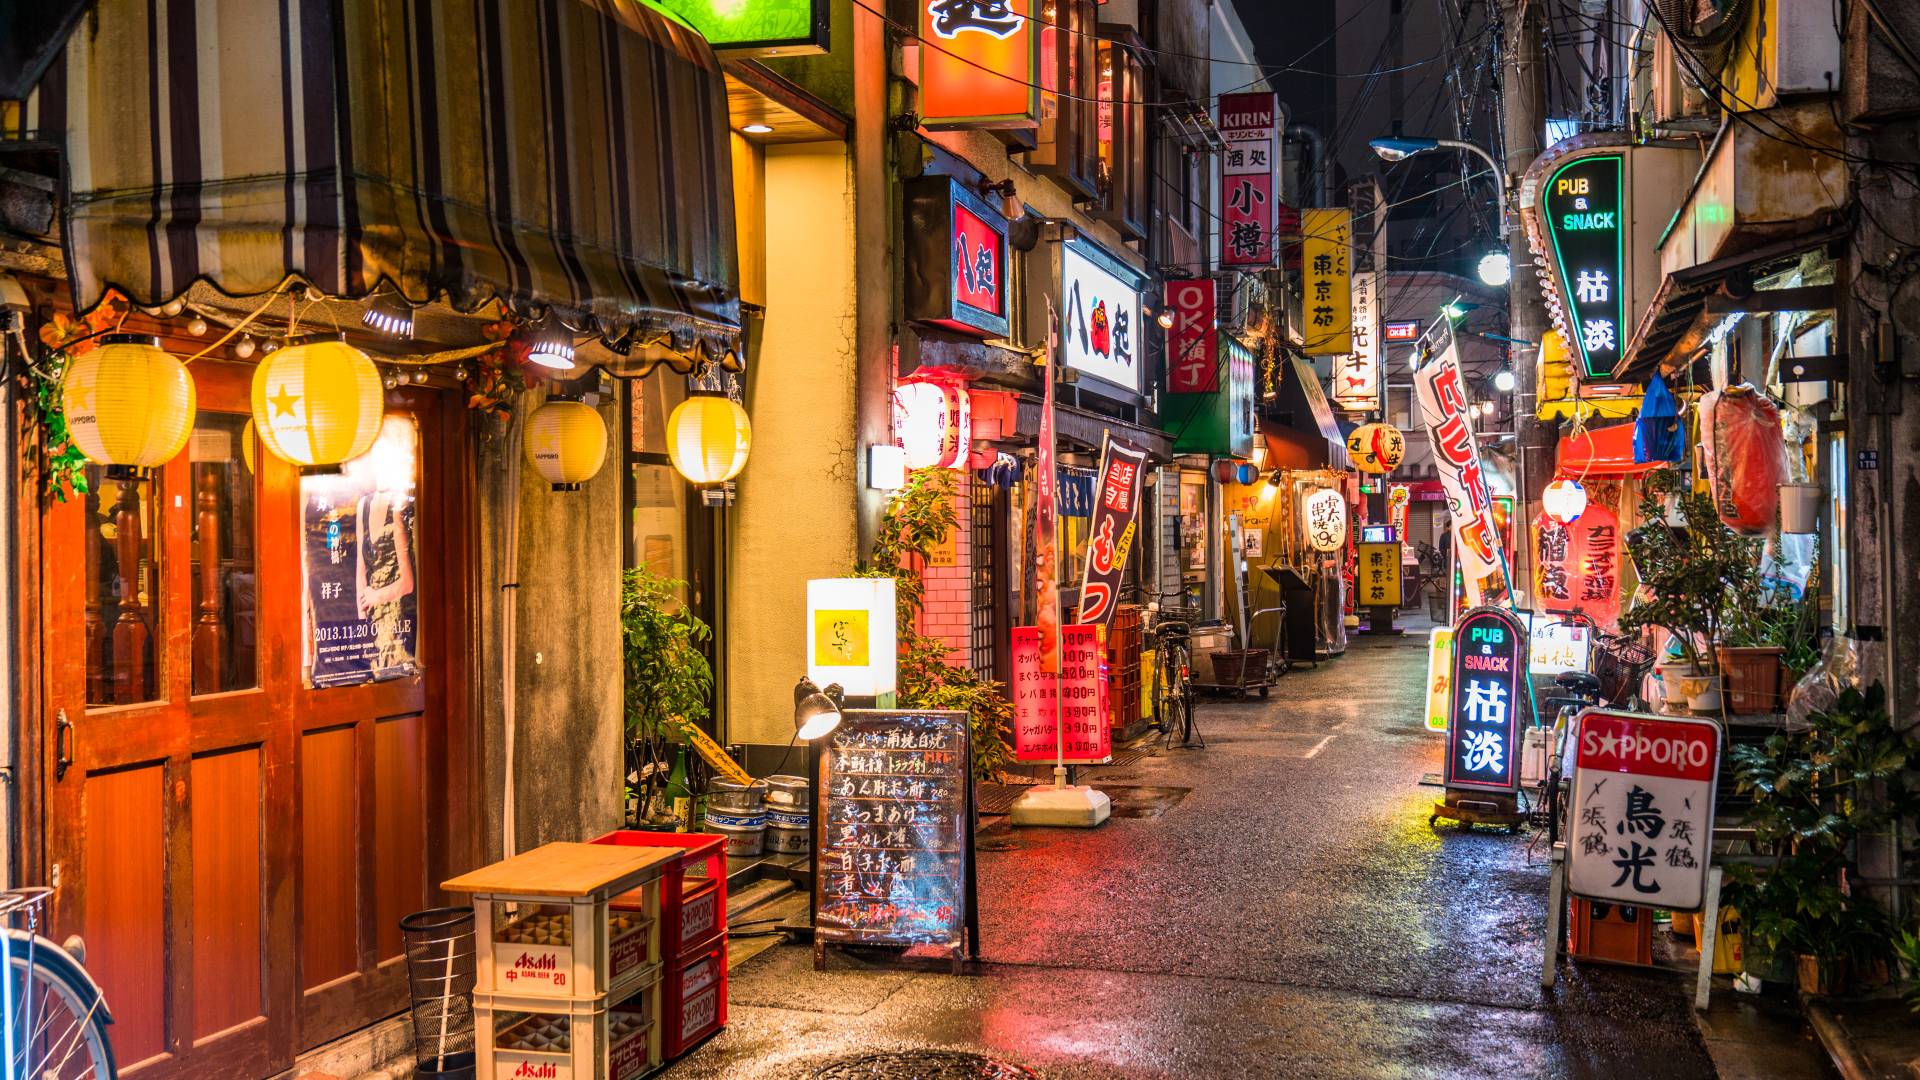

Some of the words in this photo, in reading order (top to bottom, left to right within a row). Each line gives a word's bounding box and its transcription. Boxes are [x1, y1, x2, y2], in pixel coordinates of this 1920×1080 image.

[1223, 112, 1271, 128] KIRIN
[1227, 149, 1267, 167] 酒処
[1558, 178, 1589, 196] PUB
[1229, 179, 1265, 258] 小樽
[1563, 212, 1615, 230] SNACK
[1313, 254, 1334, 327] 東京苑
[1178, 286, 1206, 386] OK横丁
[321, 582, 342, 600] 祥子
[315, 624, 368, 642] 2013.11.20
[1471, 628, 1504, 643] PUB
[1465, 655, 1509, 672] SNACK
[1461, 679, 1509, 775] 枯淡
[515, 952, 556, 970] Asahi
[506, 970, 518, 982] 中
[554, 973, 566, 985] 20
[515, 1060, 557, 1078] Asahi
